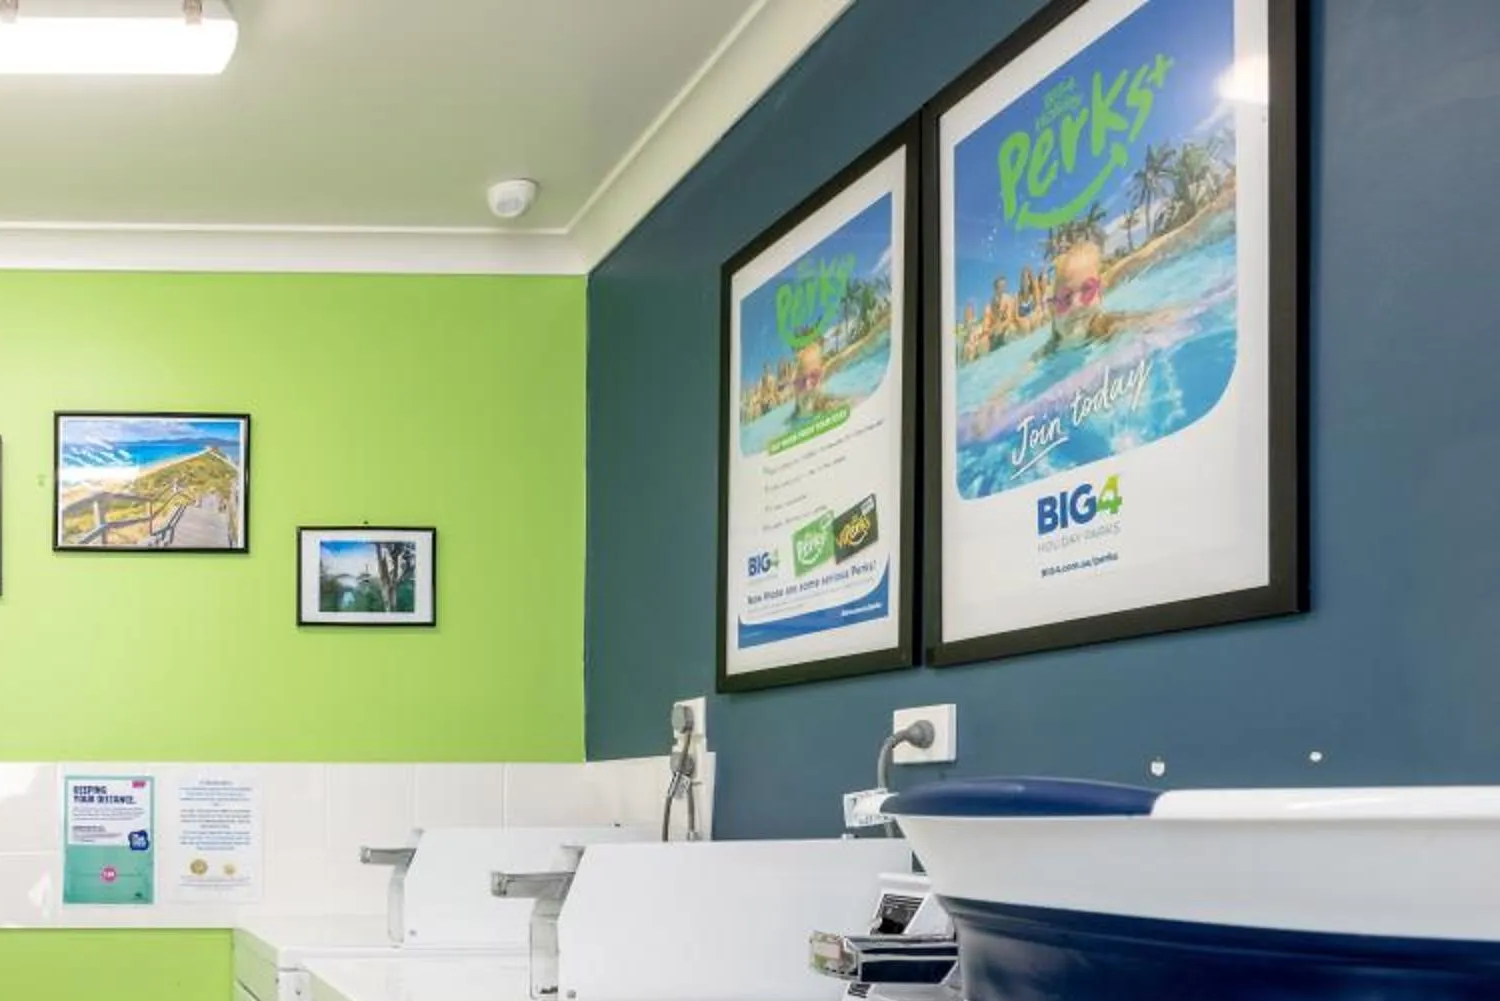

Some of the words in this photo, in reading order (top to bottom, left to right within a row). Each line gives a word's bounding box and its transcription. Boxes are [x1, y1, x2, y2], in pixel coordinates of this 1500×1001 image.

[1012, 415, 1062, 465] Join
[1070, 358, 1153, 427] today
[1038, 474, 1123, 535] BIG4
